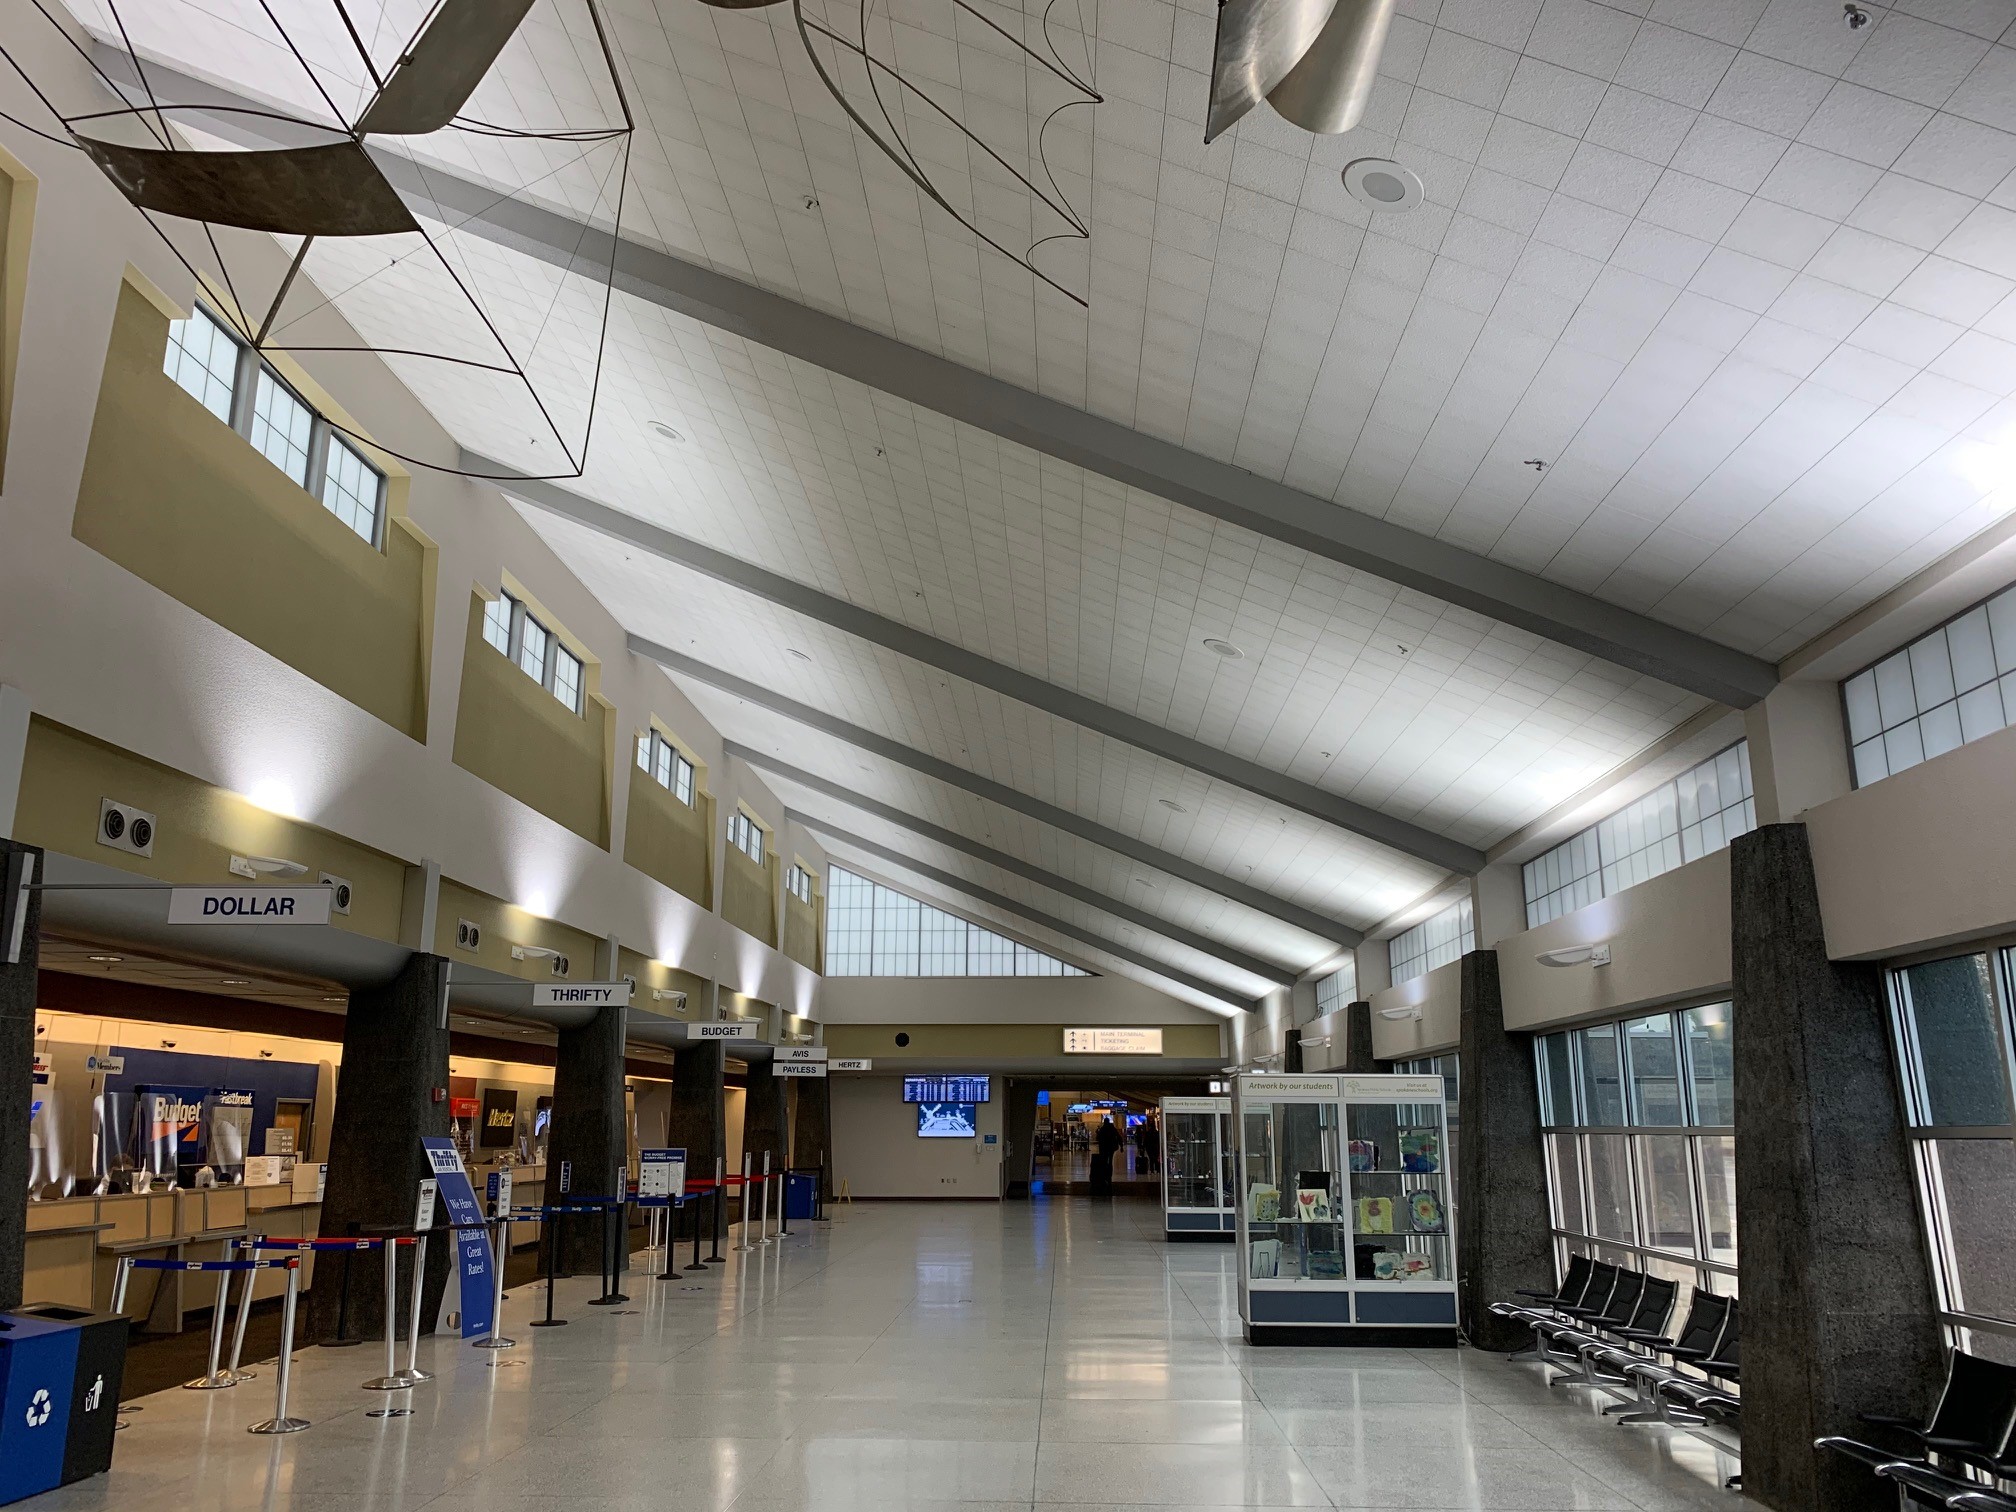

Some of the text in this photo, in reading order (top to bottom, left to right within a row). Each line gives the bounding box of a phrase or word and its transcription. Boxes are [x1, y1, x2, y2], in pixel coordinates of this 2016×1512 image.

[203, 896, 295, 916] DOLLAR
[551, 988, 612, 1002] THRIFTY
[701, 1026, 742, 1036] BUDGET
[792, 1050, 809, 1058] AVIS
[782, 1066, 817, 1074] PAYLESS
[838, 1061, 861, 1069] HERTZ
[1248, 1082, 1278, 1090] Artwork
[1279, 1082, 1288, 1091] by
[1302, 1082, 1334, 1090] students
[153, 1097, 202, 1128] Budget
[487, 1108, 515, 1127] Hertz
[430, 1150, 459, 1172] Thrifty
[449, 1198, 474, 1210] We Have
[461, 1213, 475, 1224] Cars
[458, 1229, 486, 1242] Available at
[466, 1246, 482, 1258] Great
[467, 1261, 485, 1276] Rates!
